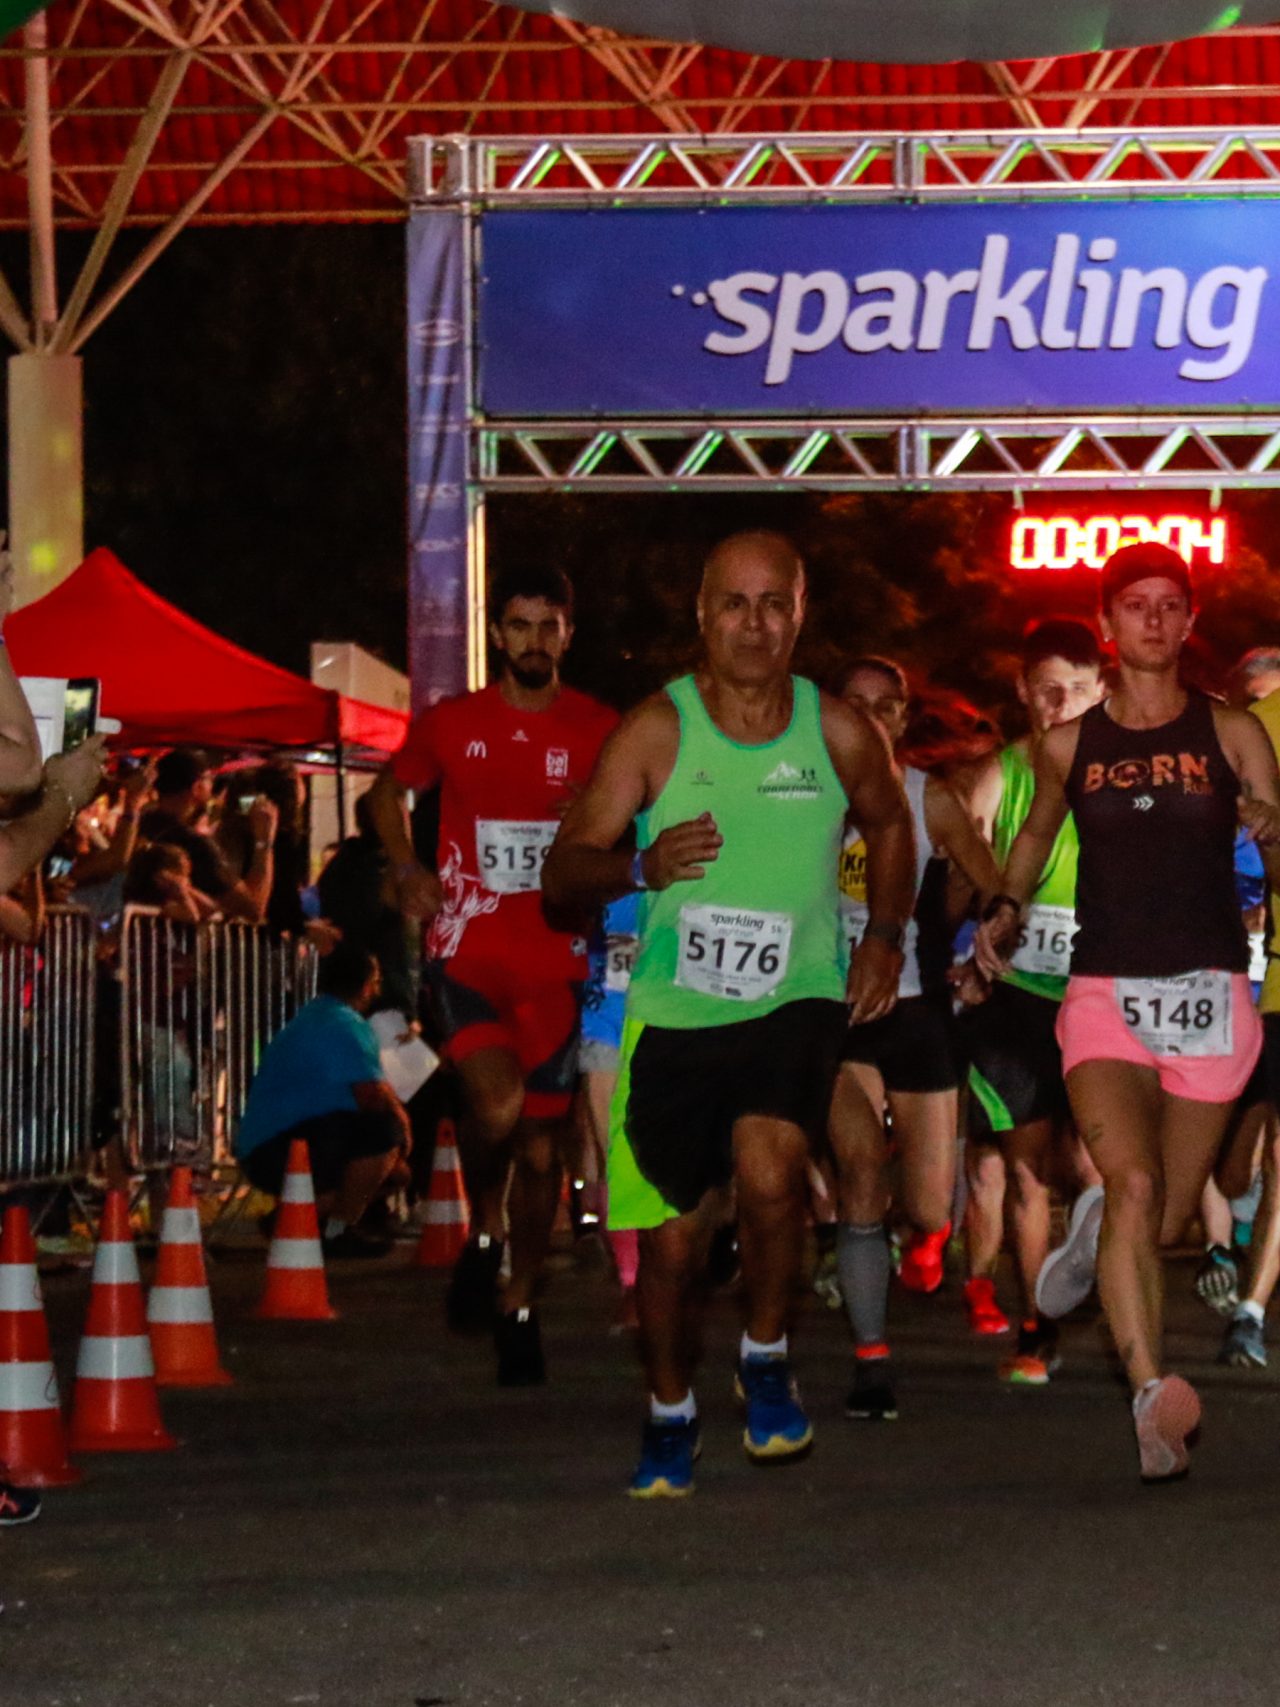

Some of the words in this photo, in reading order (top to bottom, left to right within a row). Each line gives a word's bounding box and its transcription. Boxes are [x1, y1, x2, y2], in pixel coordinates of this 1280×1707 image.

[703, 234, 1268, 386] sparkling
[1083, 752, 1210, 793] BORN
[711, 914, 765, 930] sparkling
[686, 931, 780, 975] 5176
[1123, 996, 1213, 1030] 5148
